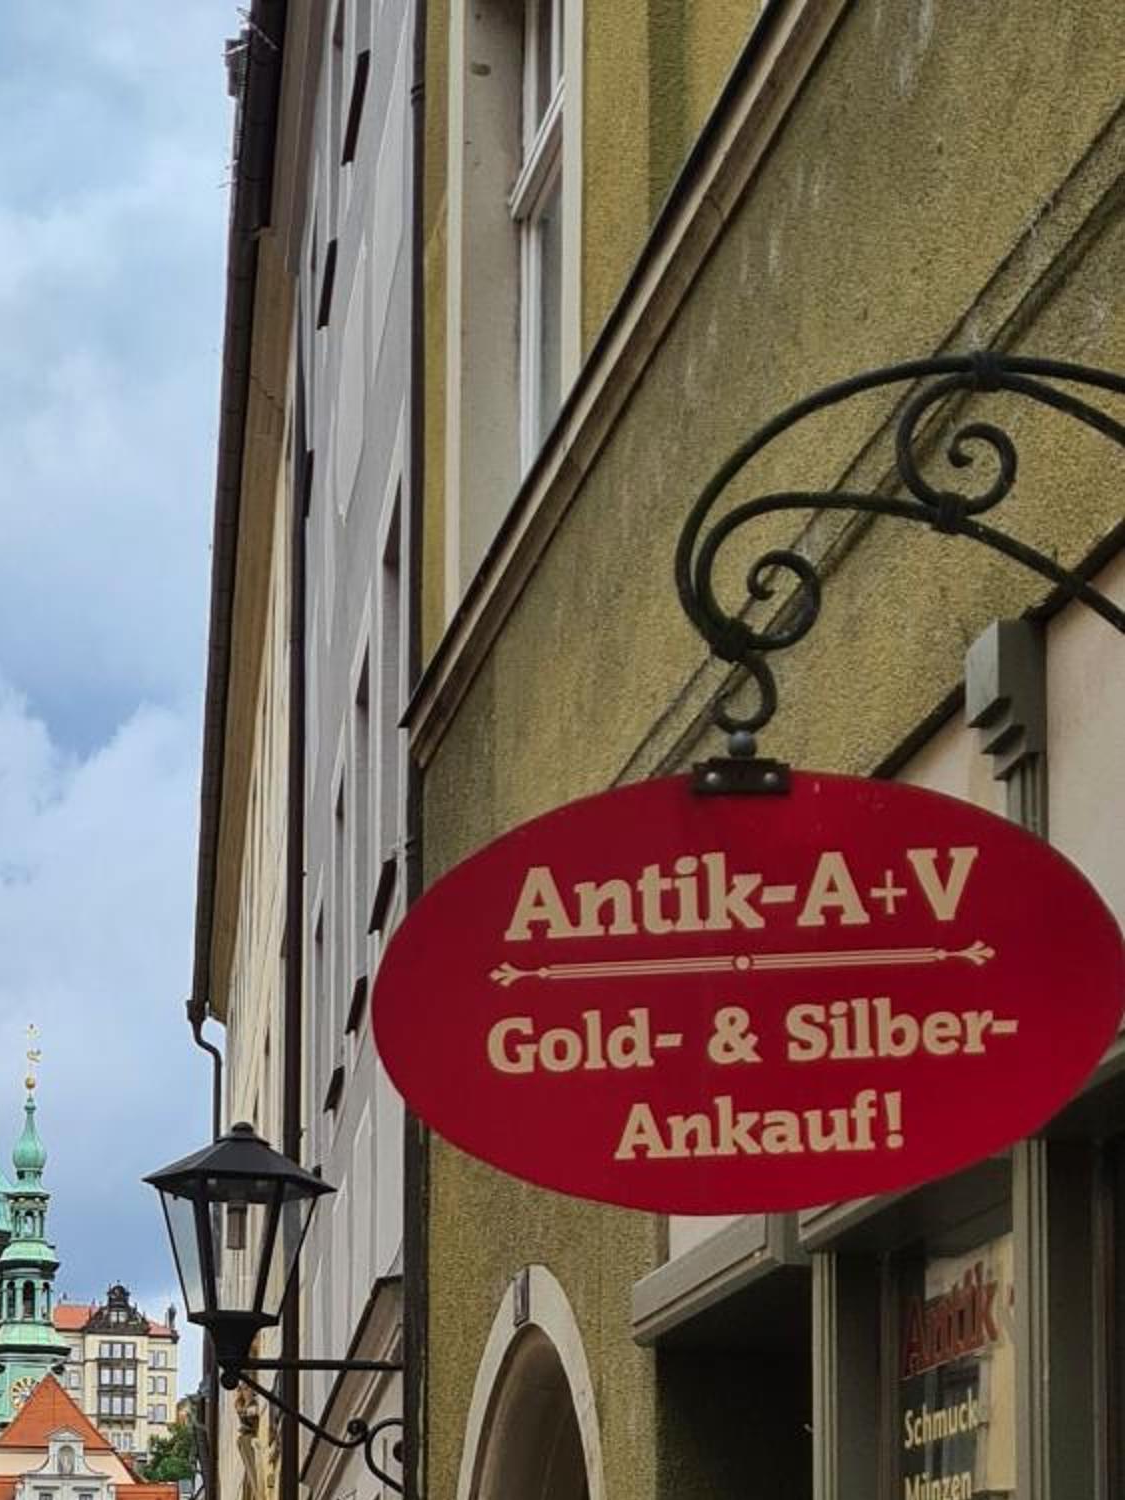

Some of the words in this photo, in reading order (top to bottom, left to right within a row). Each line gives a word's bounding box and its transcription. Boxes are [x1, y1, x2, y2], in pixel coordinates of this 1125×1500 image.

[504, 846, 979, 941] Antik-A+V
[487, 1007, 683, 1074] Gold-
[707, 1006, 763, 1065] &
[786, 997, 1019, 1062] Silber-
[613, 1090, 904, 1160] Ankauf!
[904, 1387, 980, 1449] Schmuck
